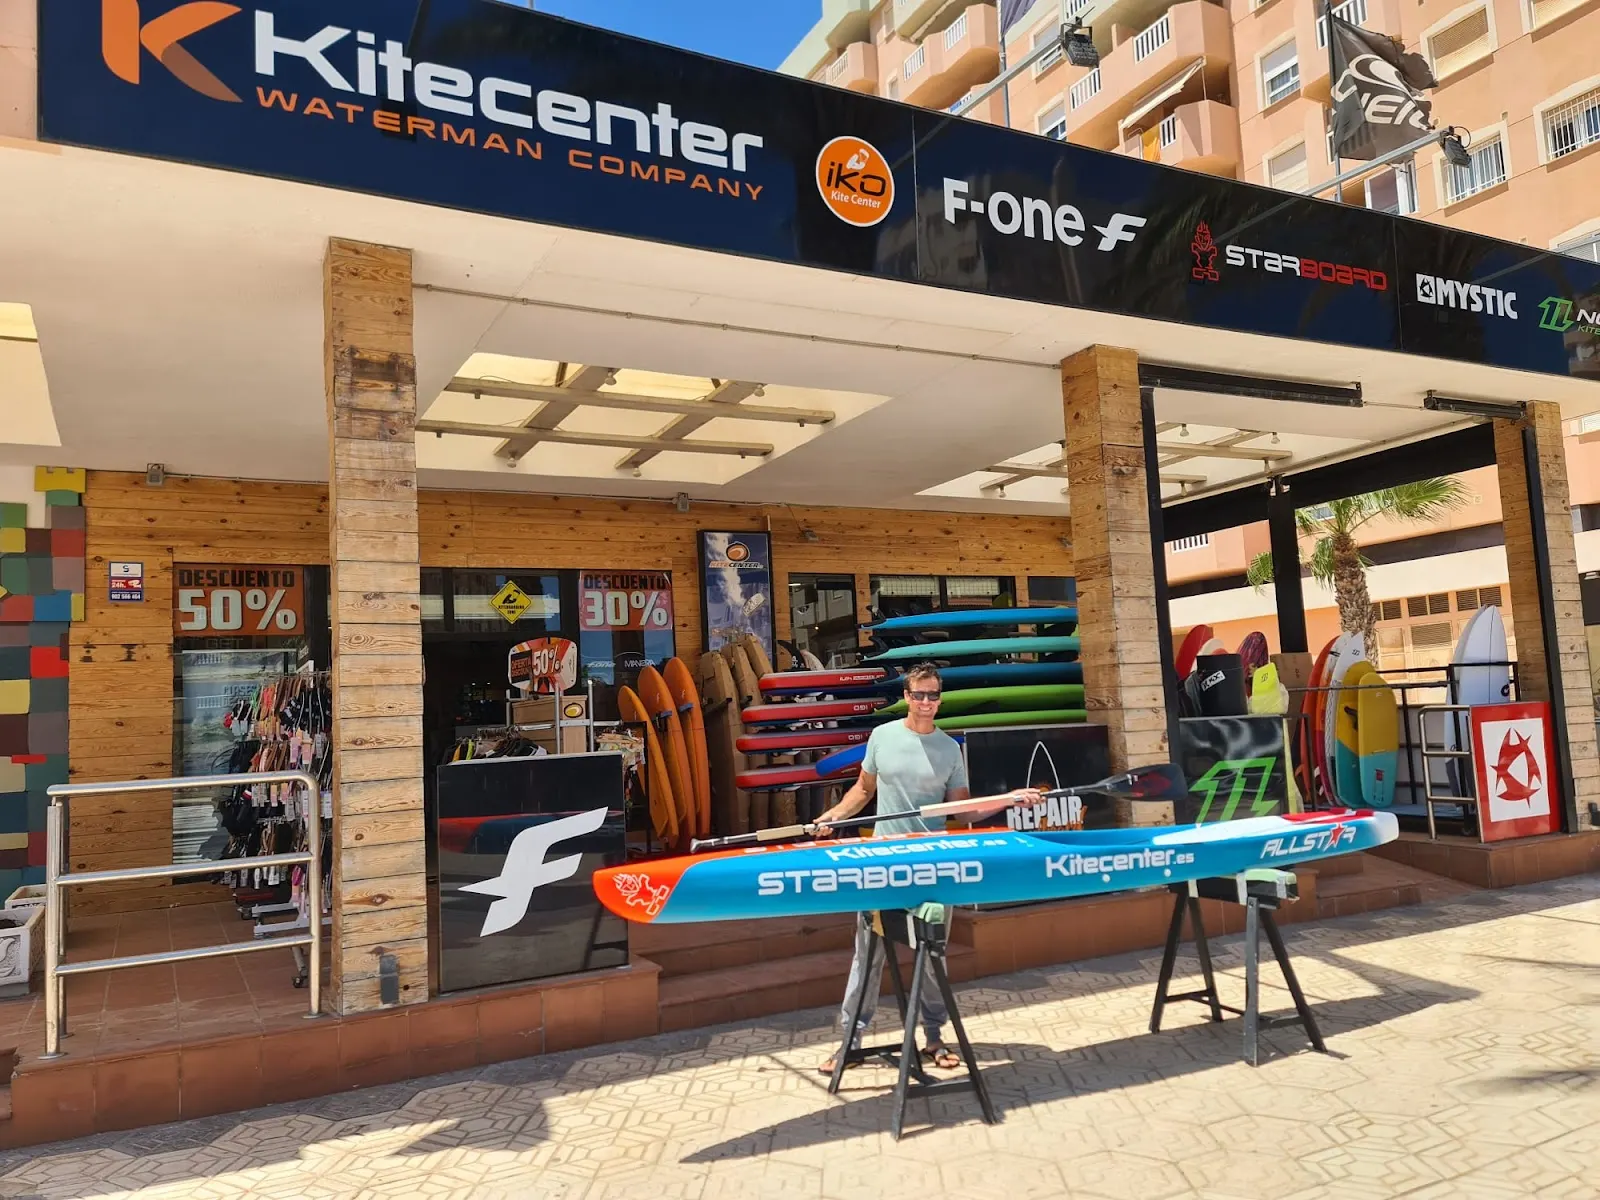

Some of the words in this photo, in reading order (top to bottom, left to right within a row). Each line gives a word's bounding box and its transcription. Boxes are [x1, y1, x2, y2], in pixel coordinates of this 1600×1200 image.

[255, 9, 764, 173] Kitecenter
[256, 86, 543, 160] WATERMAN
[568, 149, 764, 201] COMPANY
[831, 190, 850, 202] Kite
[851, 194, 882, 209] Center
[1436, 278, 1519, 320] MYSTIC
[179, 569, 295, 588] DESCUENTO
[584, 575, 666, 589] DESCUENTO
[179, 589, 297, 631] 50%
[584, 591, 668, 626] 30%
[532, 643, 561, 676] 50%
[757, 860, 984, 896] STARBOARD
[1045, 847, 1195, 879] Kitecenter.es
